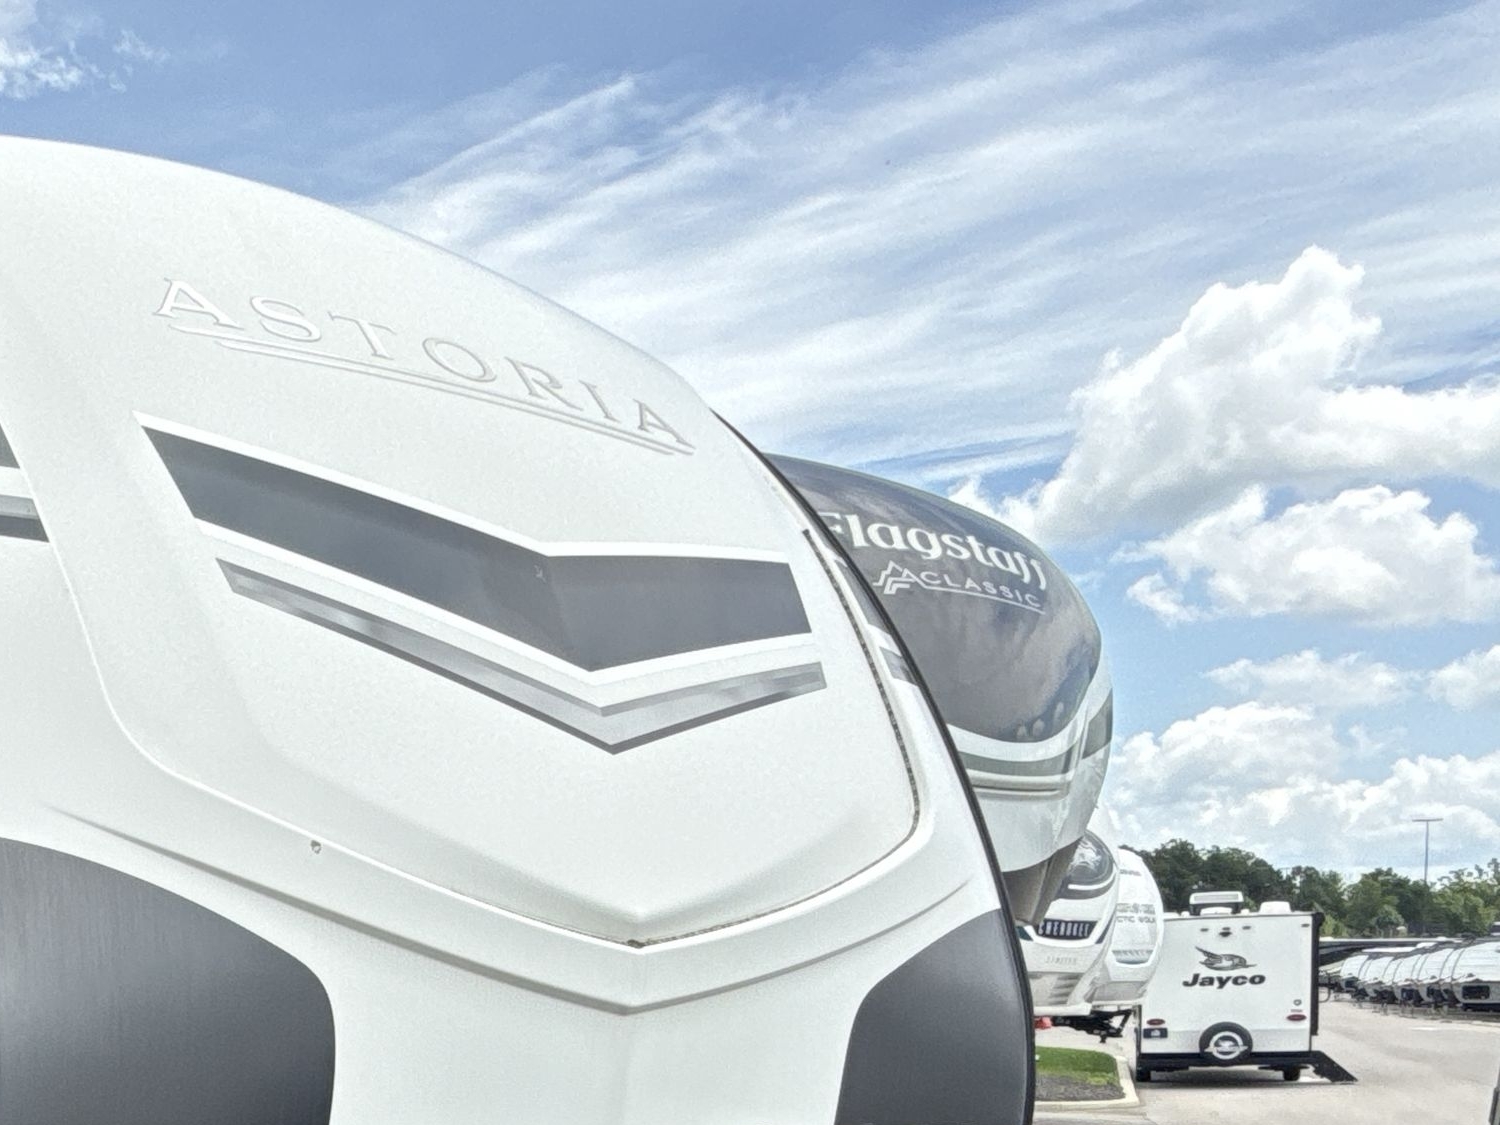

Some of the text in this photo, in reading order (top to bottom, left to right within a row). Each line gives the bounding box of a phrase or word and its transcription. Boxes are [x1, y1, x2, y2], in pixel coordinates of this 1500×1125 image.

[152, 277, 697, 450] ASTORIA
[920, 570, 1042, 608] CLASSIC
[1182, 973, 1266, 989] Jayco
